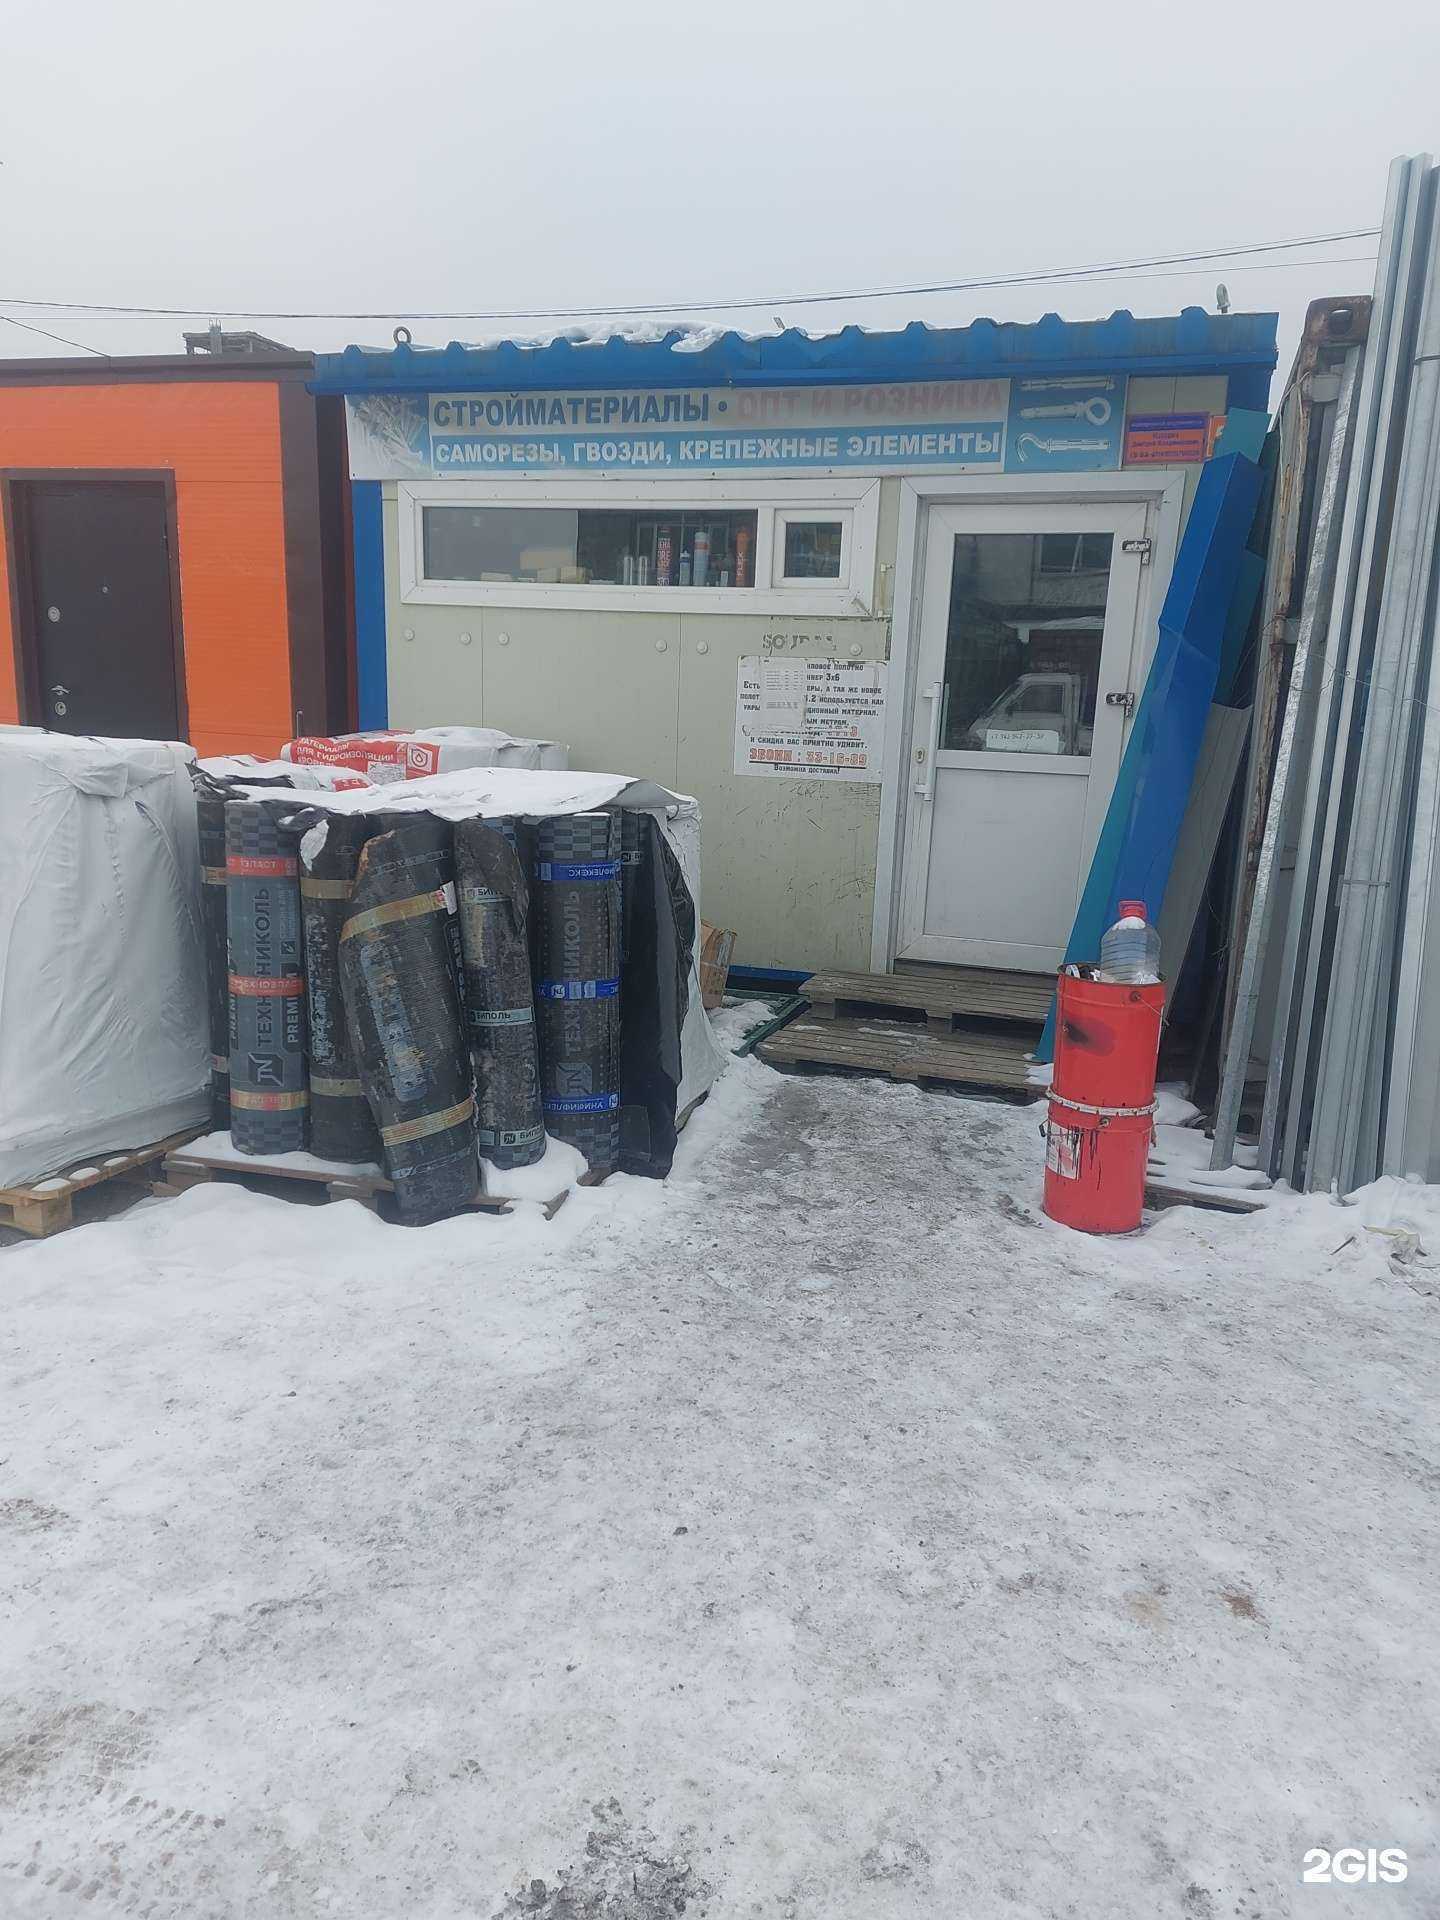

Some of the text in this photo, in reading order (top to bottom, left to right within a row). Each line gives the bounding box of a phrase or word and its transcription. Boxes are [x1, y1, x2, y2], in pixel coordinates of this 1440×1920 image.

[433, 382, 1000, 427] СТРОЙМАТЕРИАЛЫ ОПТ И РОЗНИЦА
[435, 431, 1000, 465] САМОРЕЗЫ, ГВОЗДИ, КРЕПЕЖНЫЕ ЭЛЕМЕНТЫ
